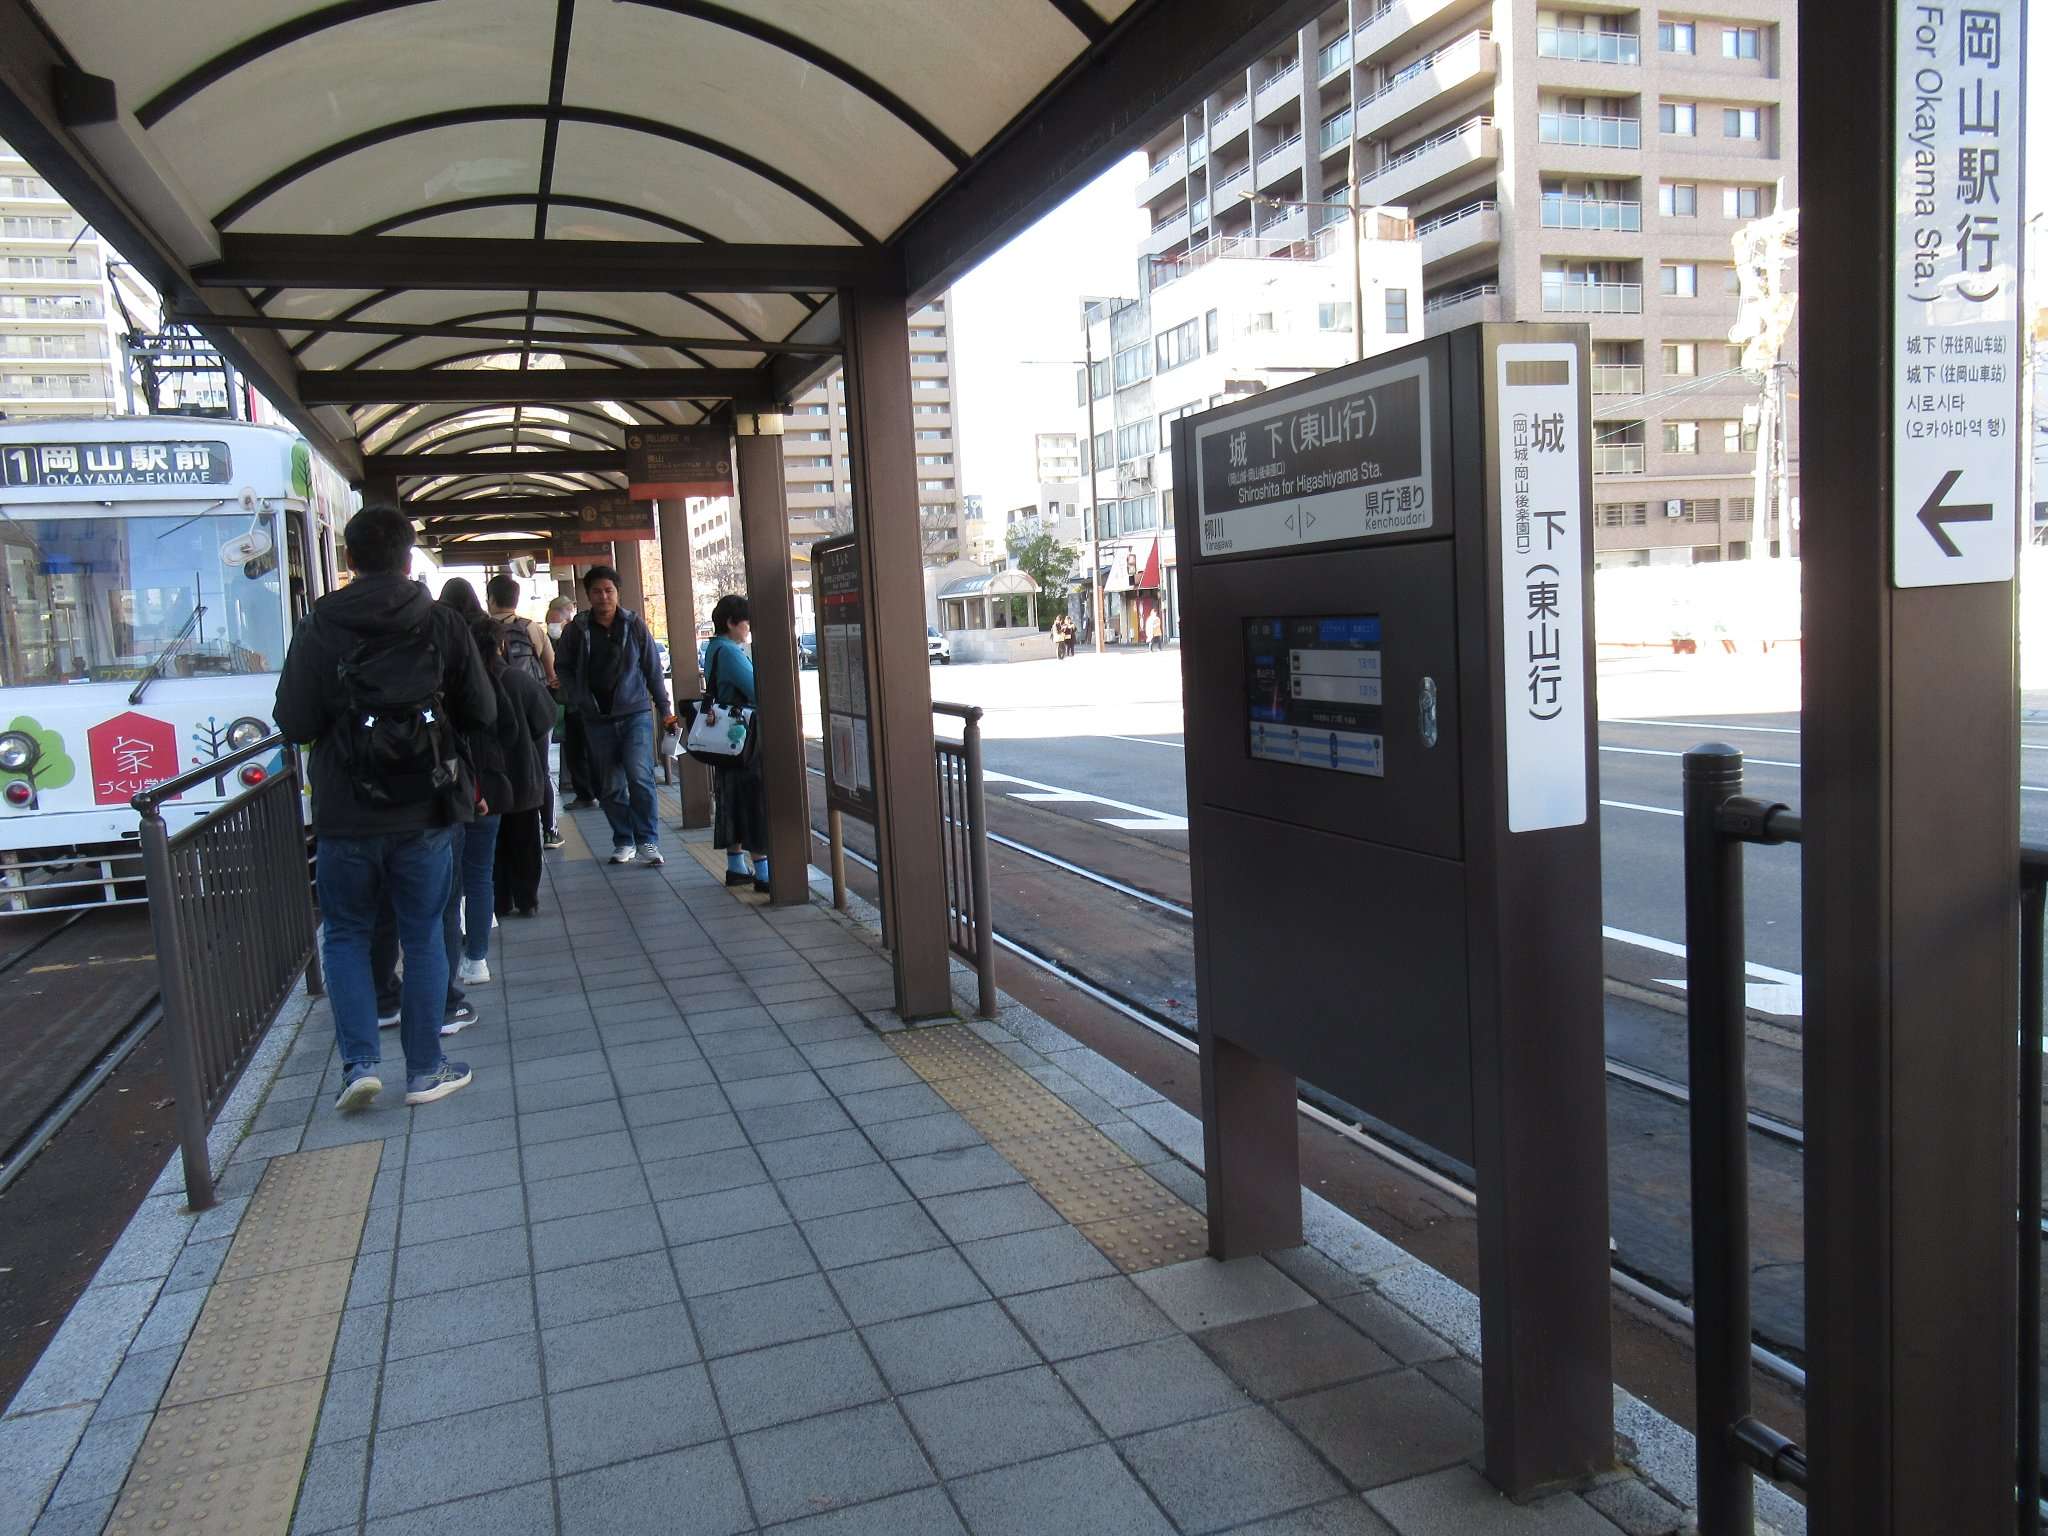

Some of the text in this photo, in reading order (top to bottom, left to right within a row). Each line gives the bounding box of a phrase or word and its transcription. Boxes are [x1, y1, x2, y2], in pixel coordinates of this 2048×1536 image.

[1907, 5, 1943, 302] For Okayama Sta.)
[1906, 393, 1965, 413] 시로시타
[1906, 417, 2006, 439] (오카야마역 행)
[11, 450, 29, 483] 1
[41, 445, 210, 473] 岡山駅前
[46, 471, 210, 486] OKAYAMA-EKIMAE
[1238, 461, 1383, 504] Shiroshita for Higashiyama Sta.
[1364, 484, 1425, 518] 県庁通り
[1365, 510, 1425, 531] Kenchoudori
